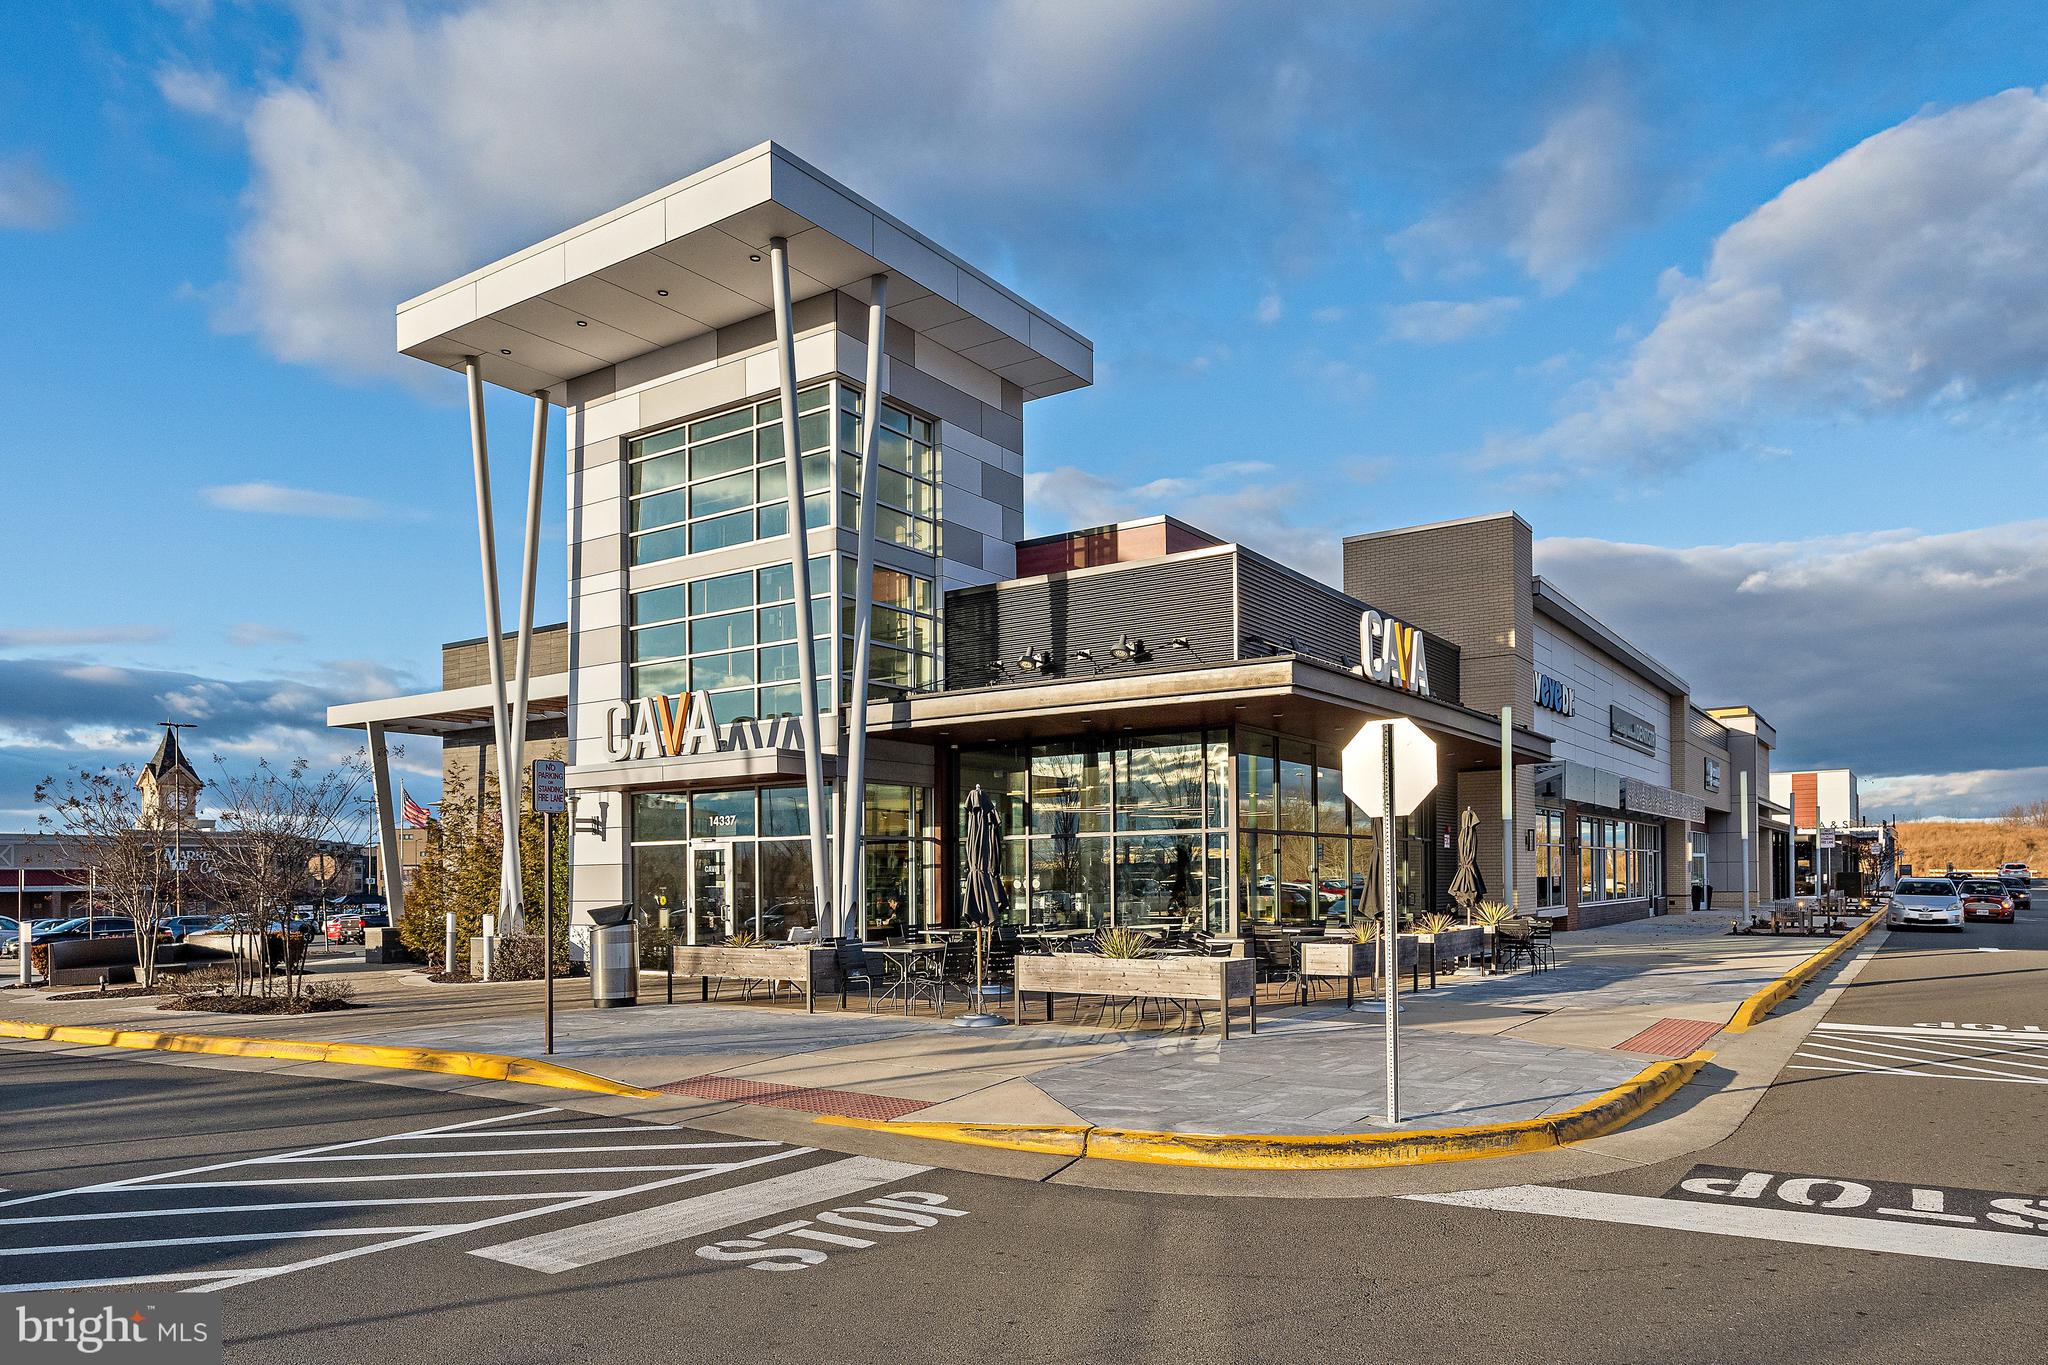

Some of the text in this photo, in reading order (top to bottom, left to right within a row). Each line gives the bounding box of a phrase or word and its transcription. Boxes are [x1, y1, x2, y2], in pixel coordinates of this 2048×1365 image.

[1360, 610, 1430, 696] CAVA
[604, 689, 720, 762] CAVA
[545, 763, 556, 771] NO
[538, 771, 563, 780] PARKING
[538, 784, 563, 793] STANDING
[538, 794, 563, 803] FIRE LANE
[709, 814, 736, 827] 14337
[1681, 1172, 2048, 1231] STOP
[695, 1191, 971, 1271] STOP
